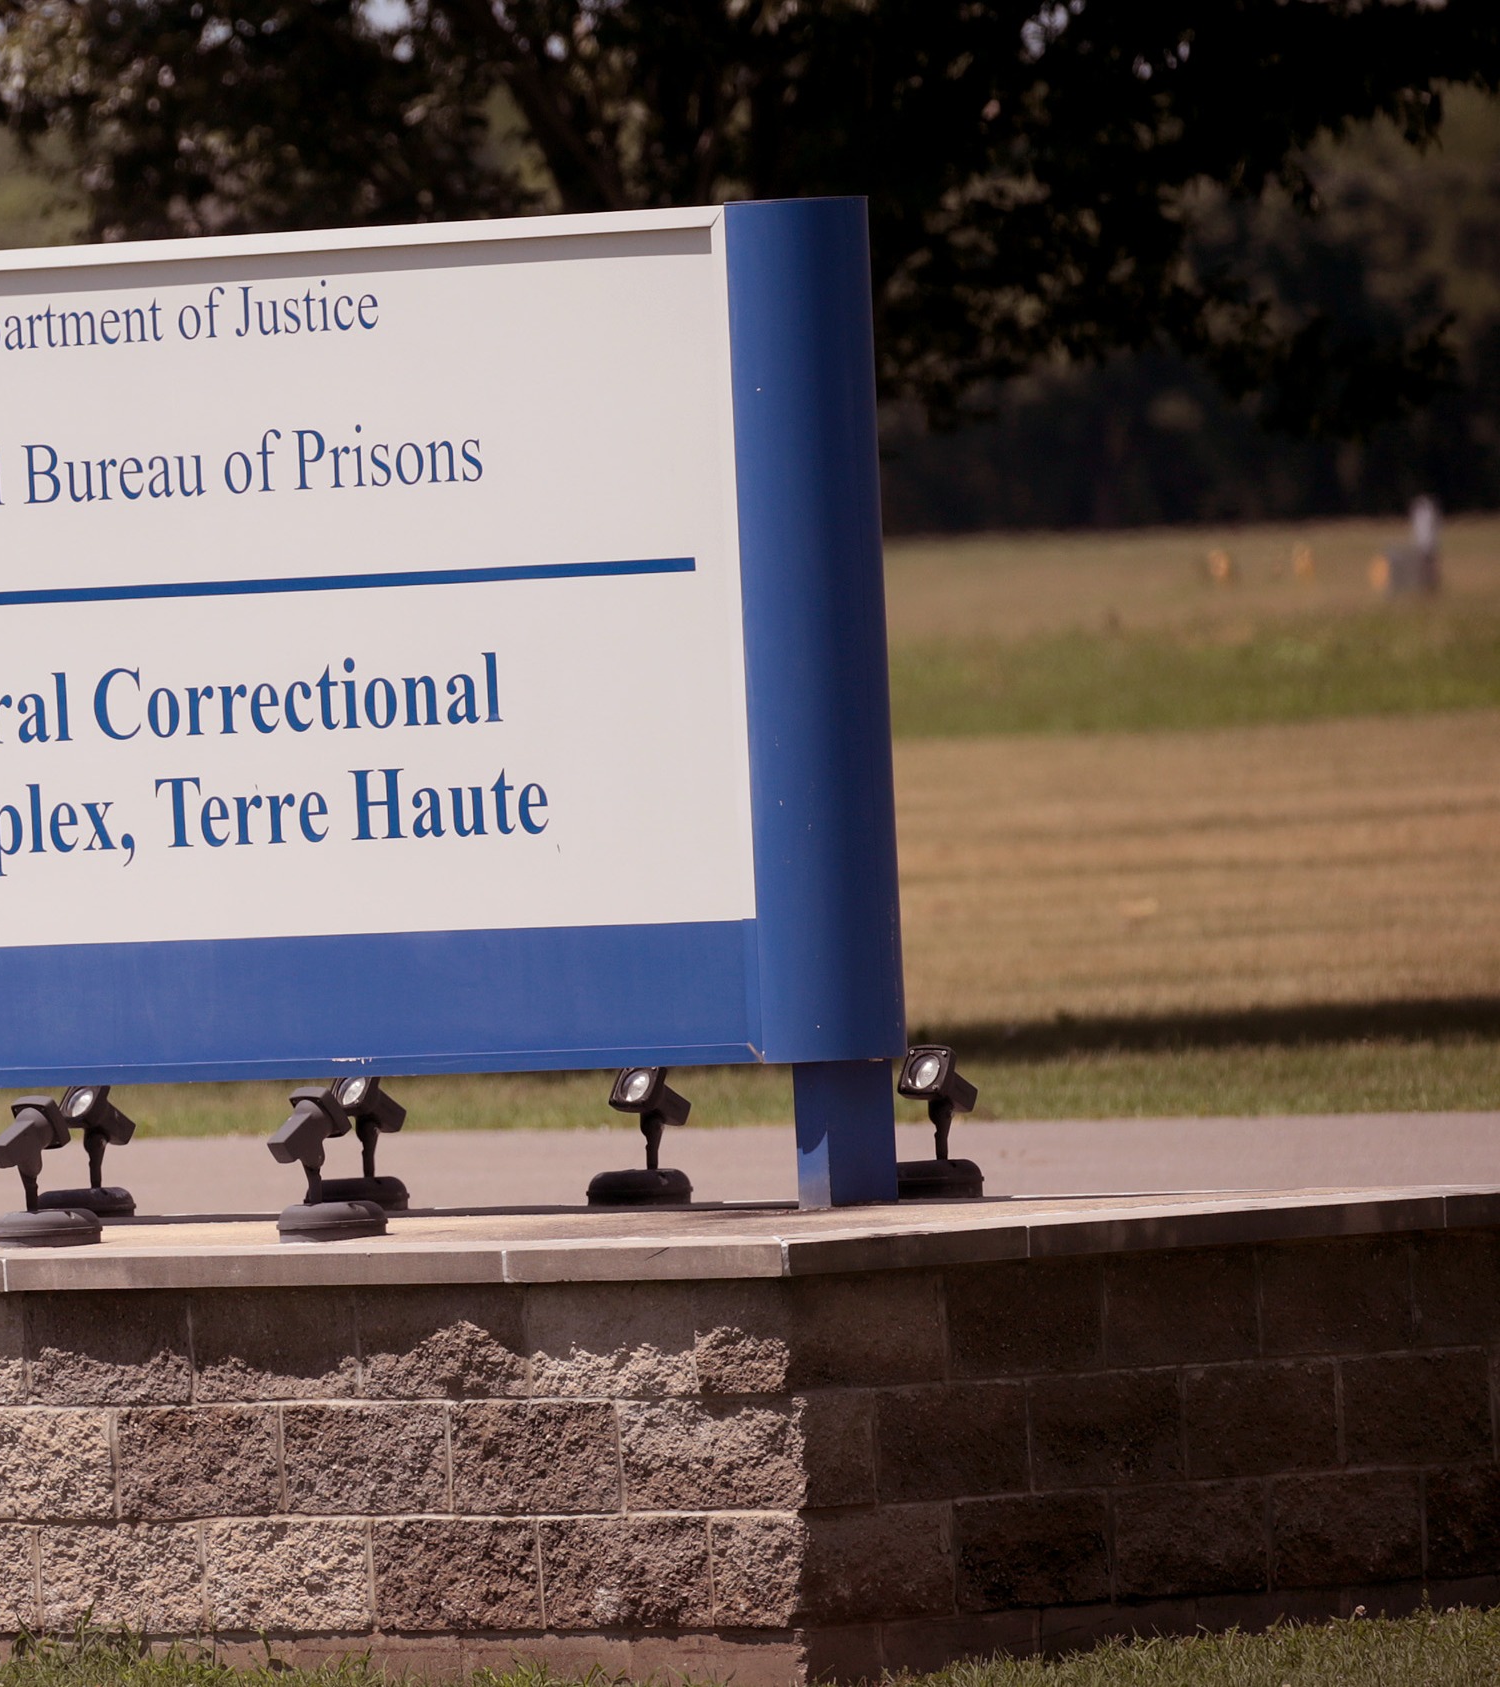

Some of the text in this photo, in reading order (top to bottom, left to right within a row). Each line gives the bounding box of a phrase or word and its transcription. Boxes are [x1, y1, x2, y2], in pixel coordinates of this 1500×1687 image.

[178, 286, 225, 341] of
[235, 279, 379, 338] Justice
[21, 445, 206, 505] Bureau
[224, 428, 282, 495] of
[291, 424, 483, 491] Prisons
[93, 651, 504, 741] Correctional
[154, 776, 330, 848] Terre
[347, 767, 549, 841] Haute
